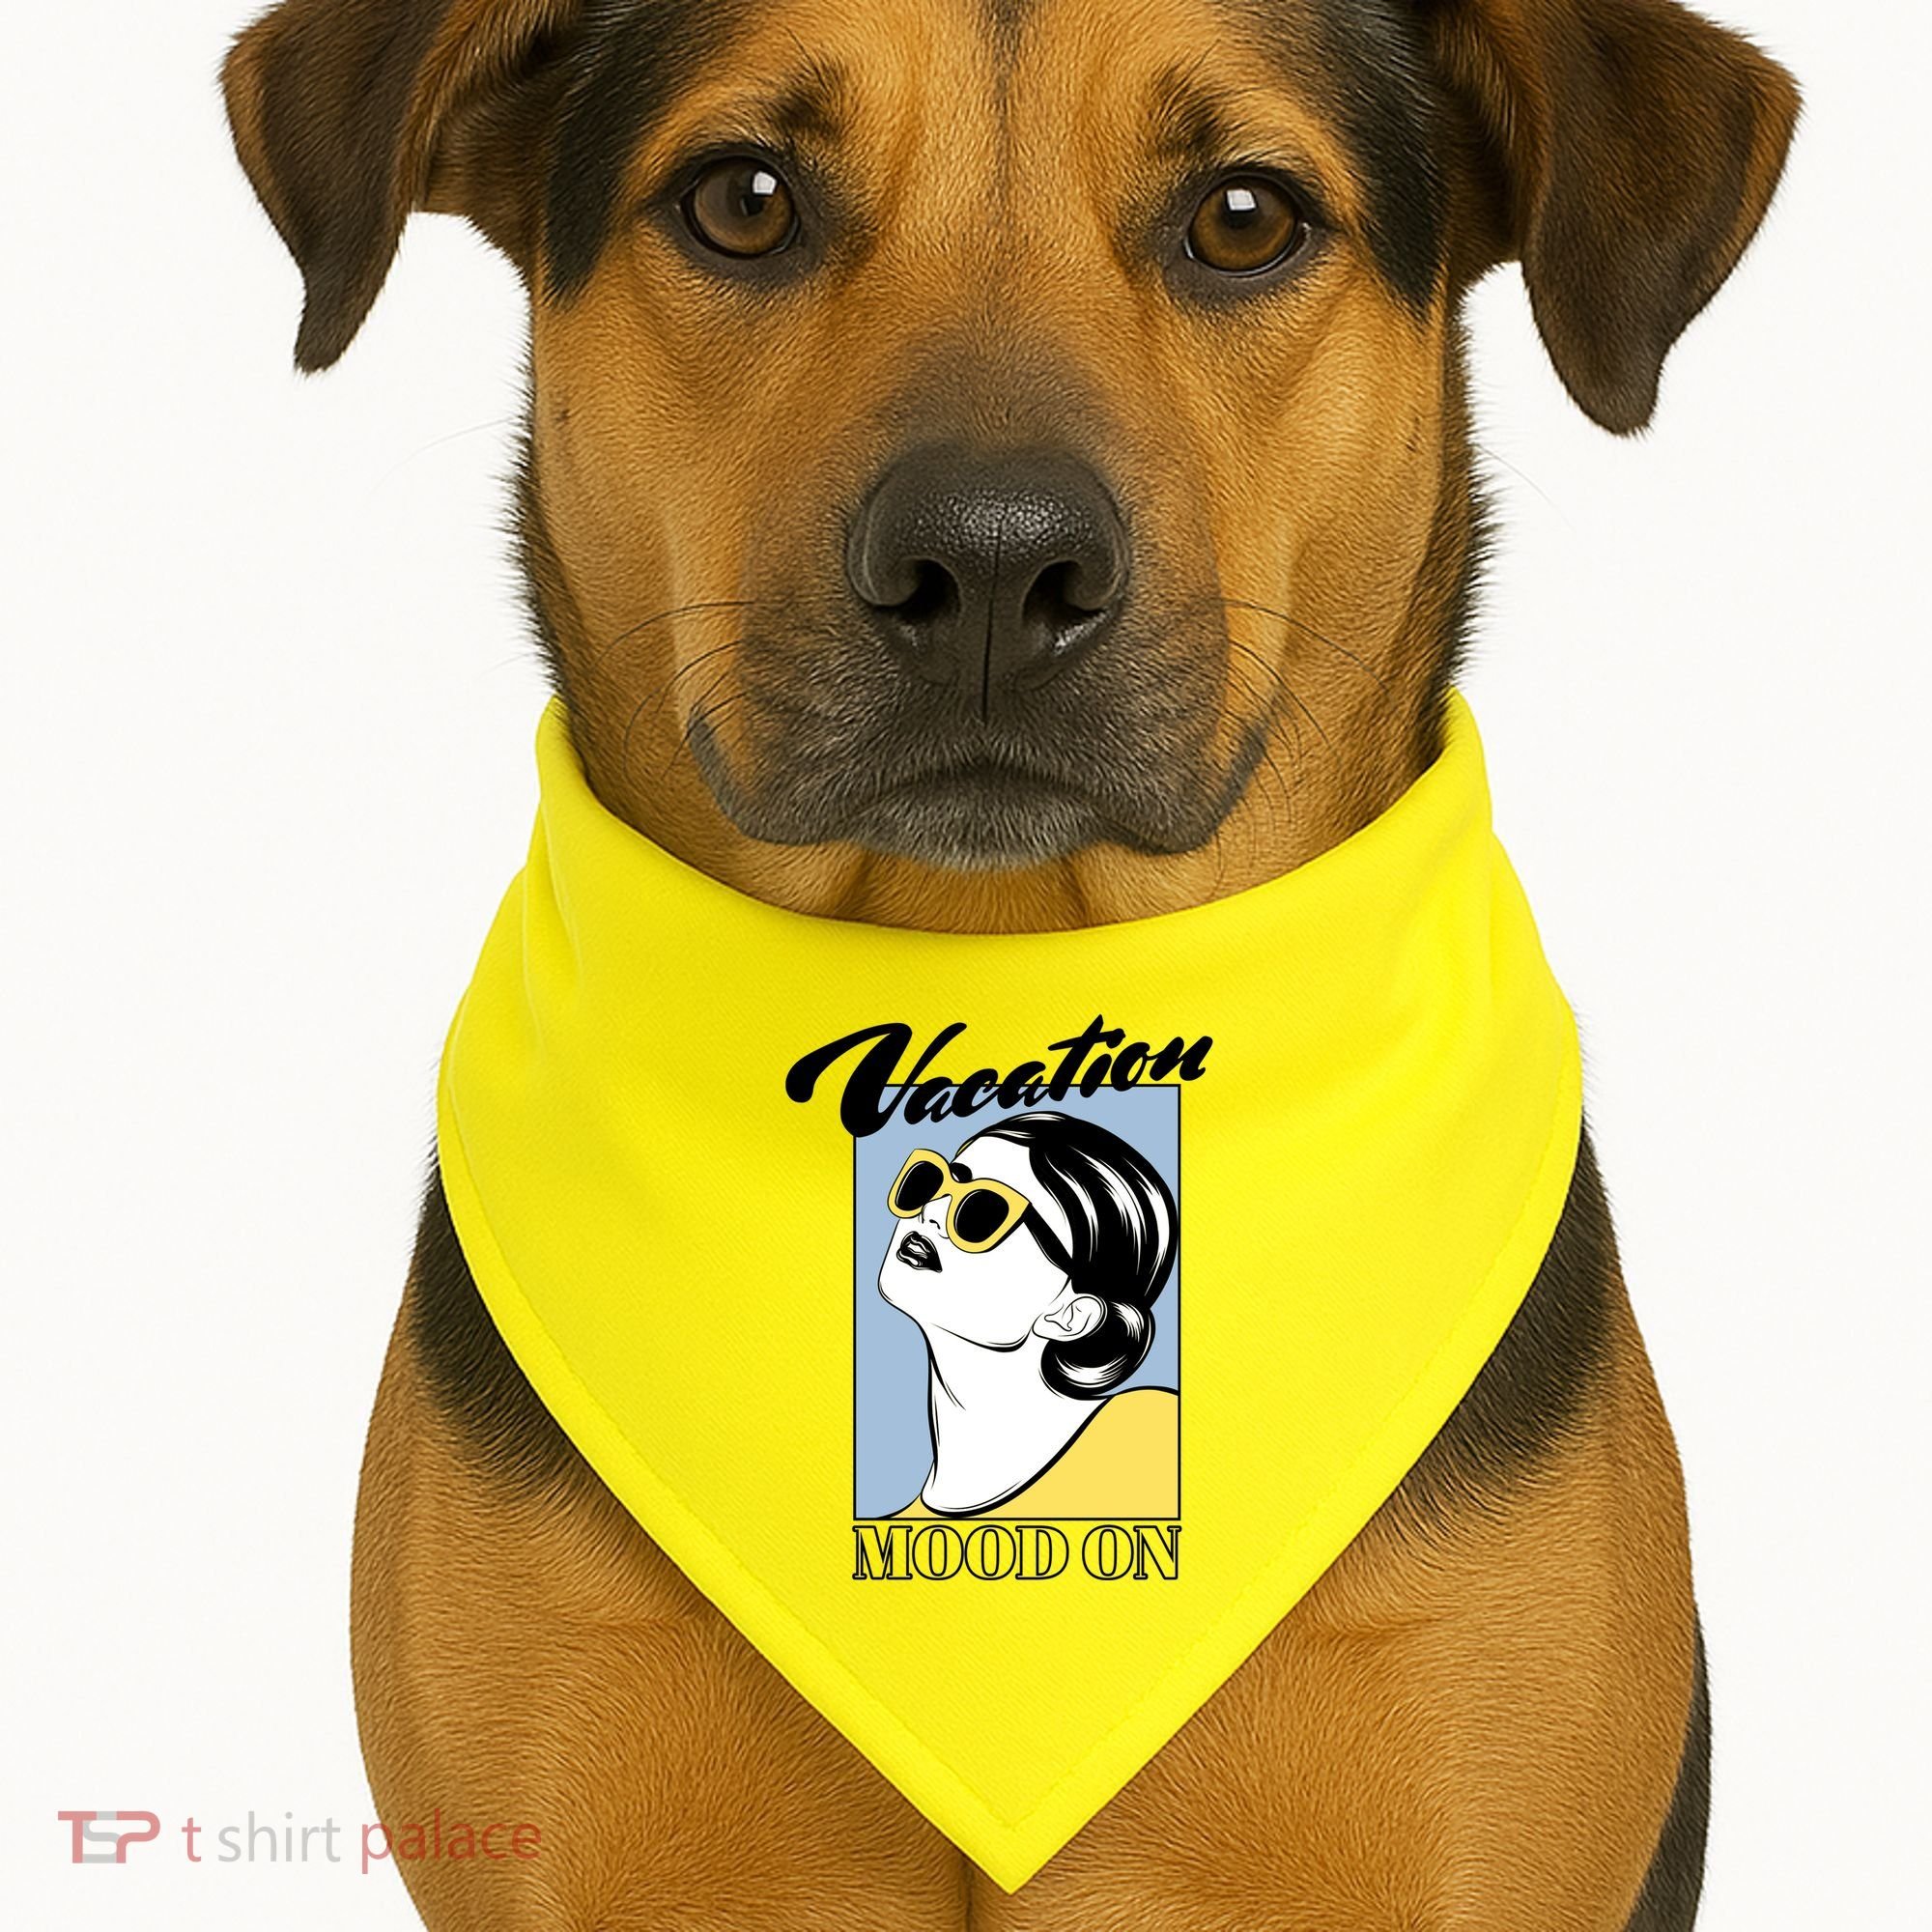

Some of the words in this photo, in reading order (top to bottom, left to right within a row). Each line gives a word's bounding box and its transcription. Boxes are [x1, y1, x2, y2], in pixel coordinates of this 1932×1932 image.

[785, 1013, 1214, 1138] Vacation
[852, 1524, 1069, 1580] MOOD
[1082, 1524, 1182, 1580] ON
